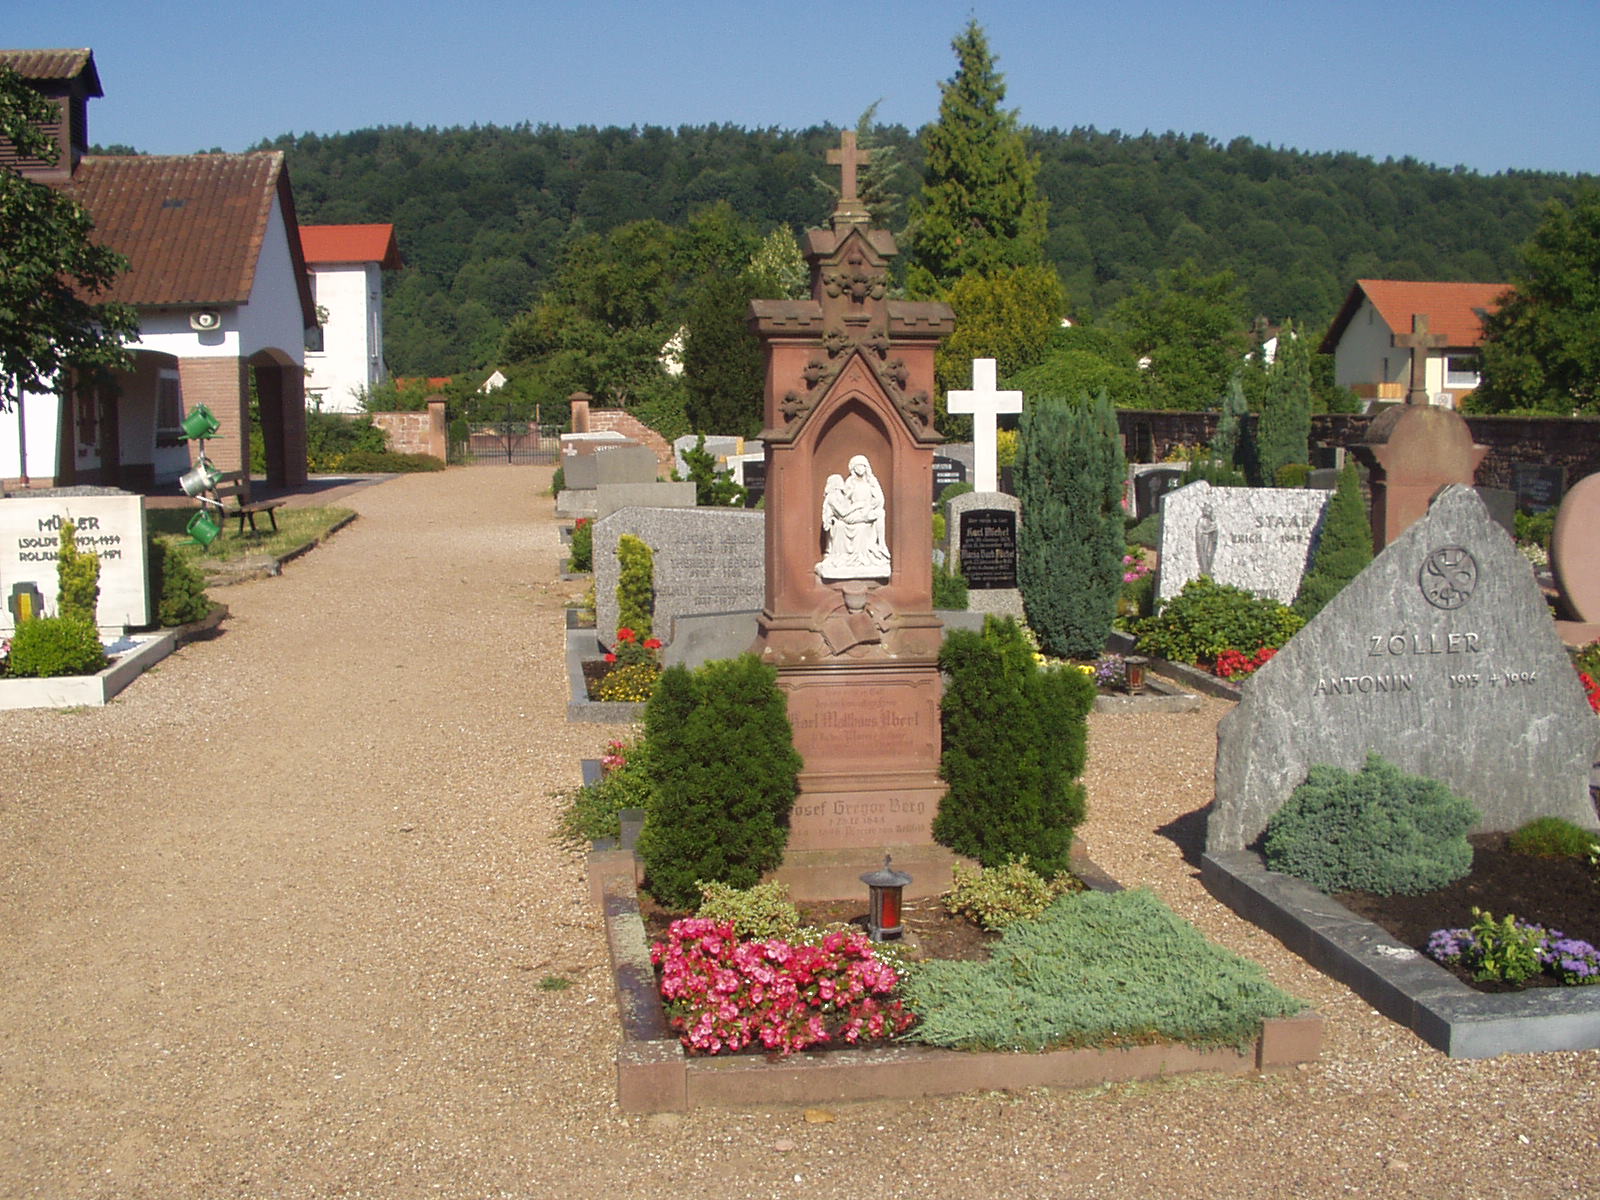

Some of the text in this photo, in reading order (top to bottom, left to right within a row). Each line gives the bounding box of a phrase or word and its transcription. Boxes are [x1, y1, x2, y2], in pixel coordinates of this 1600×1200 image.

[1255, 513, 1311, 528] STAAB
[19, 537, 58, 549] ISOLDE
[1369, 631, 1479, 657] ZÖLLER
[1313, 673, 1412, 696] ANTONIN
[889, 798, 925, 815] Berg
